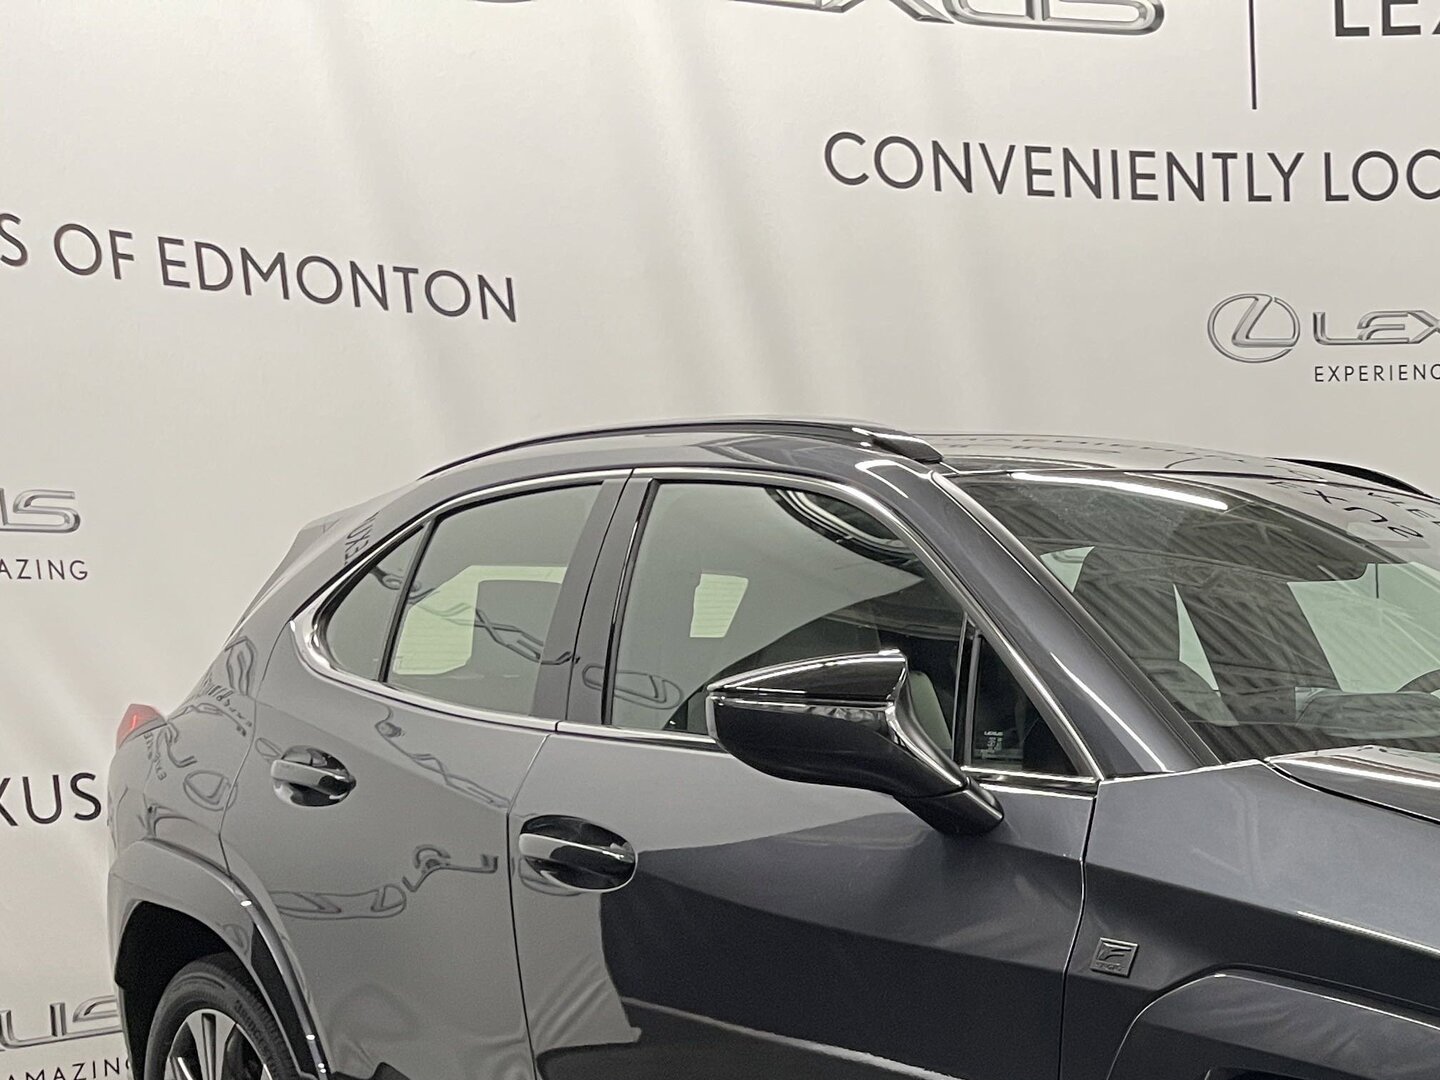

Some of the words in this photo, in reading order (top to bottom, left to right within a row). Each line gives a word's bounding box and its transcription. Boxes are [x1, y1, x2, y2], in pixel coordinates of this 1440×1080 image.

[824, 132, 1304, 202] CONVENIENTLY
[54, 223, 134, 280] OF
[157, 236, 516, 323] EDMONTON
